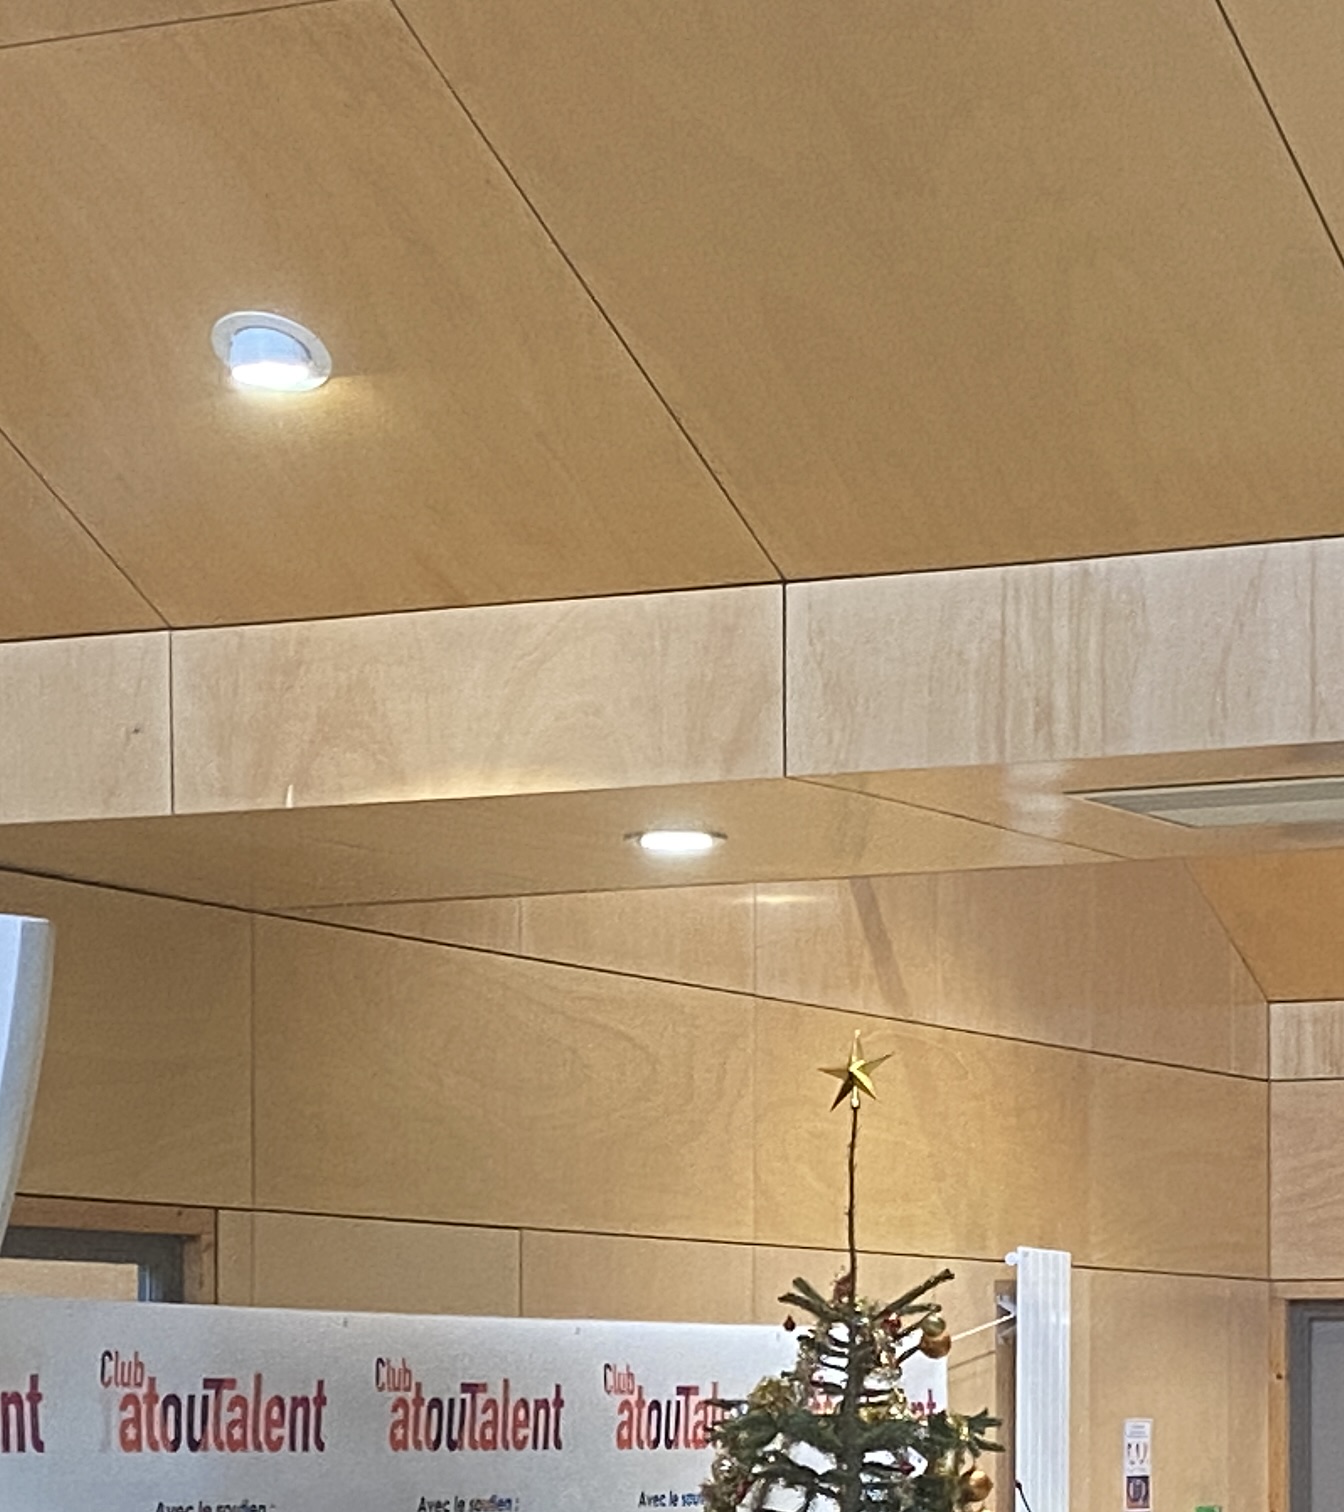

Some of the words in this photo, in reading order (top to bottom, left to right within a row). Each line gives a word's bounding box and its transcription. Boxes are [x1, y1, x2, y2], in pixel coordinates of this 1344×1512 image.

[100, 1350, 144, 1388] Club
[374, 1356, 413, 1393] Club
[604, 1363, 635, 1395] Club
[118, 1374, 327, 1454] atouTalent
[389, 1378, 564, 1451] atouTalent
